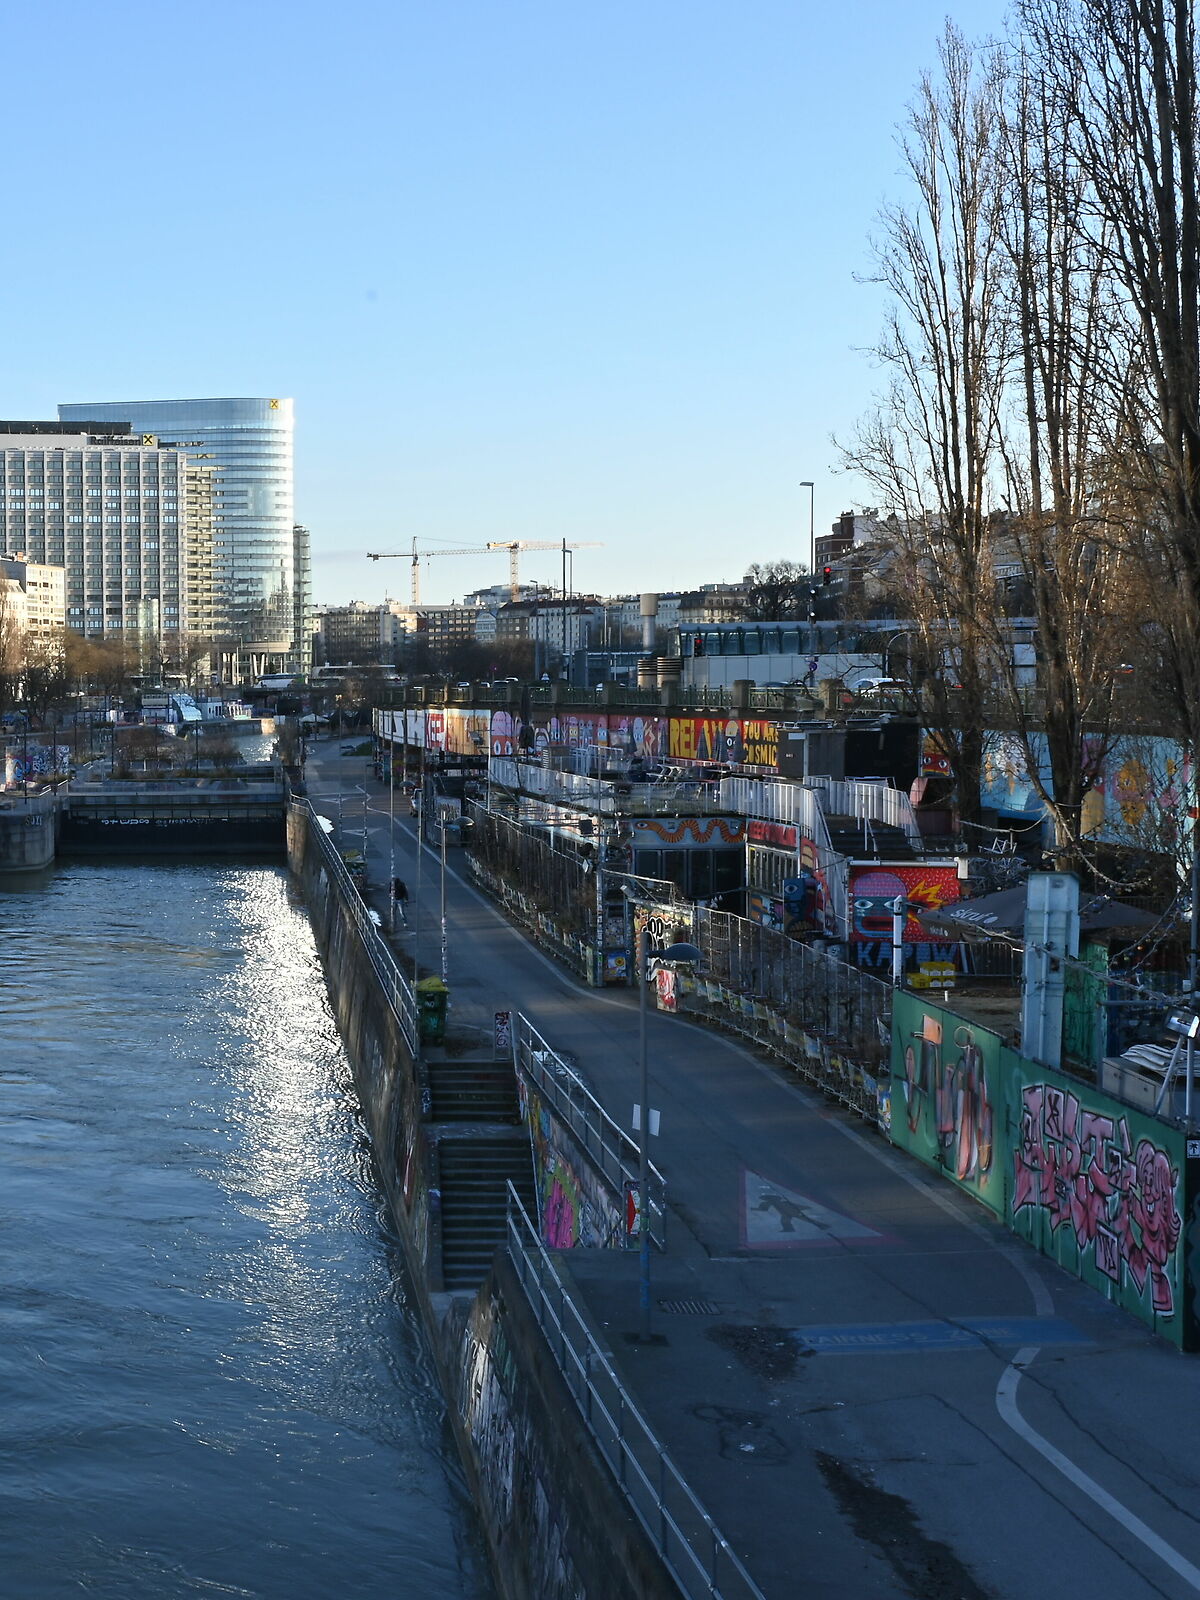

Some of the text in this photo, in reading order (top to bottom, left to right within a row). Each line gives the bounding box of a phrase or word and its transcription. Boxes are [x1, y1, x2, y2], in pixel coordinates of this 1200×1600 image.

[90, 436, 140, 446] Raiffeisen
[743, 722, 760, 740] YOU
[743, 743, 777, 766] COSMIC
[950, 908, 994, 922] skruf
[803, 1332, 928, 1345] FAIRNESS
